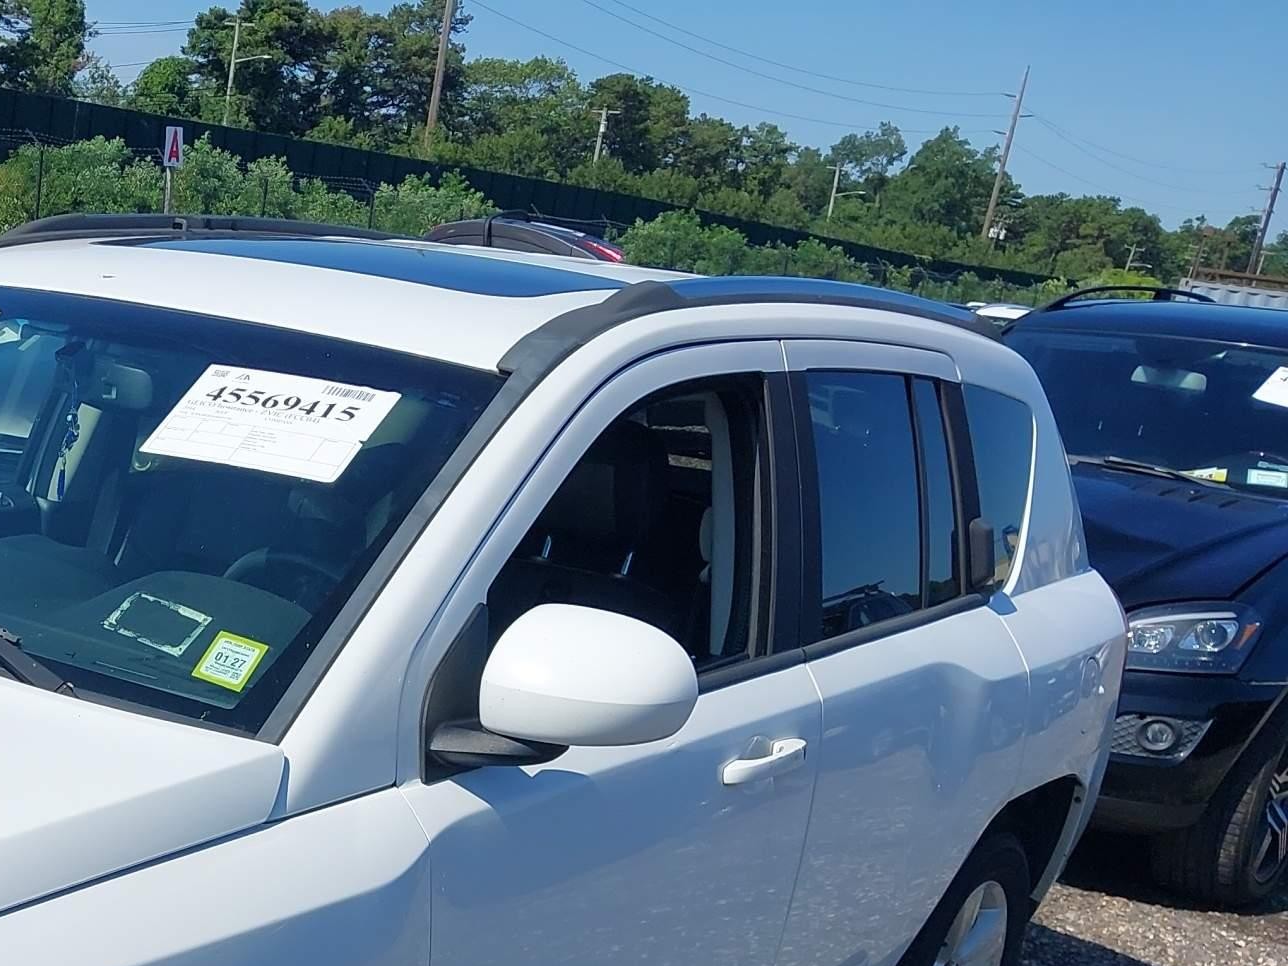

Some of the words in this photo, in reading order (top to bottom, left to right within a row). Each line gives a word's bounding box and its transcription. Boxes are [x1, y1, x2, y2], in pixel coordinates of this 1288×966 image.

[167, 127, 180, 163] A
[205, 385, 361, 422] 45569415
[230, 657, 247, 669] 27
